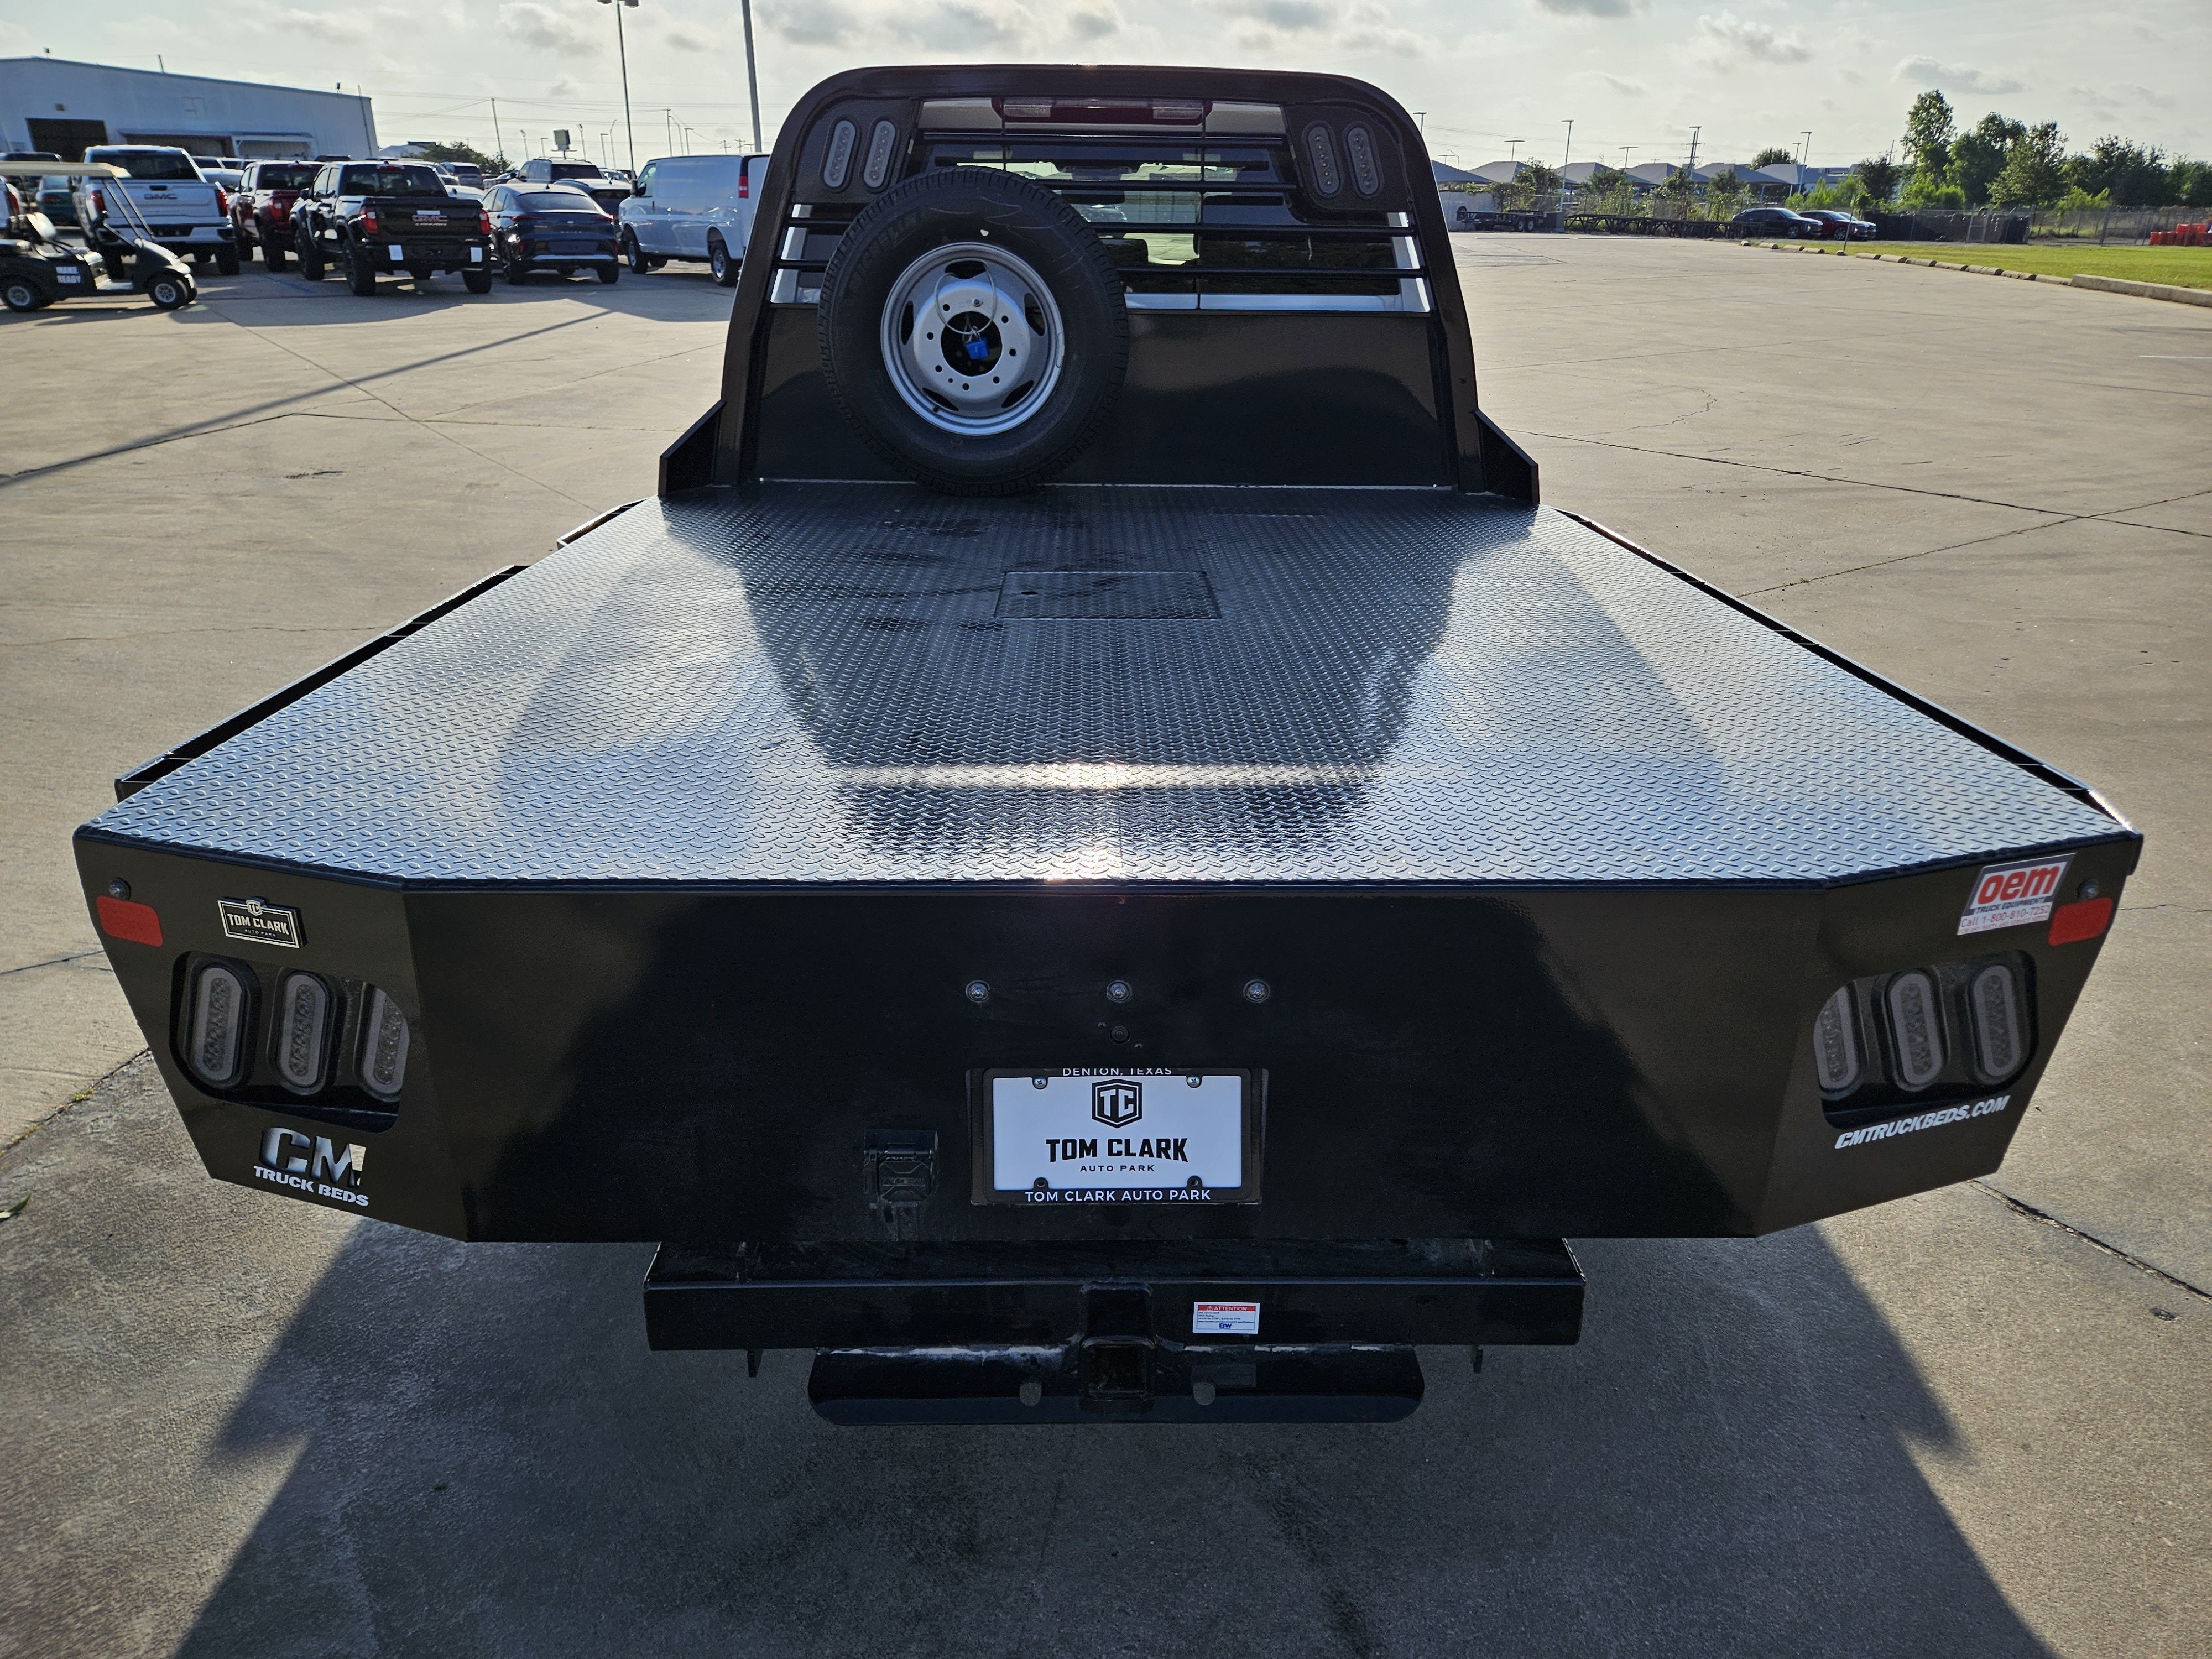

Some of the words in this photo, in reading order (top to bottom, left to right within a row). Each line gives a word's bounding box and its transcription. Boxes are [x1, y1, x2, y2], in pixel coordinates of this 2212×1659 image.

[1978, 865, 2060, 905] oem
[1961, 916, 1979, 927] Call
[1983, 905, 2051, 923] 1-800-810-7252
[1975, 904, 2000, 914] TRUCK
[2001, 896, 2045, 910] EQUIPMENT
[227, 914, 251, 926] TOM
[252, 918, 290, 935] CLARK
[1130, 1067, 1172, 1076] TEXAS
[1100, 1088, 1134, 1118] TC
[1834, 1095, 2011, 1149] CMTRUCKBEDS.COM
[259, 1126, 367, 1188] CM
[1046, 1139, 1098, 1163] TOM
[1107, 1138, 1189, 1162] CLARK
[253, 1165, 314, 1192] TRUCK
[318, 1183, 369, 1207] BEDS
[1025, 1191, 1058, 1202] TOM
[1065, 1190, 1116, 1202] CLARK
[1121, 1190, 1164, 1201] AUTO
[1169, 1189, 1211, 1201] PARK
